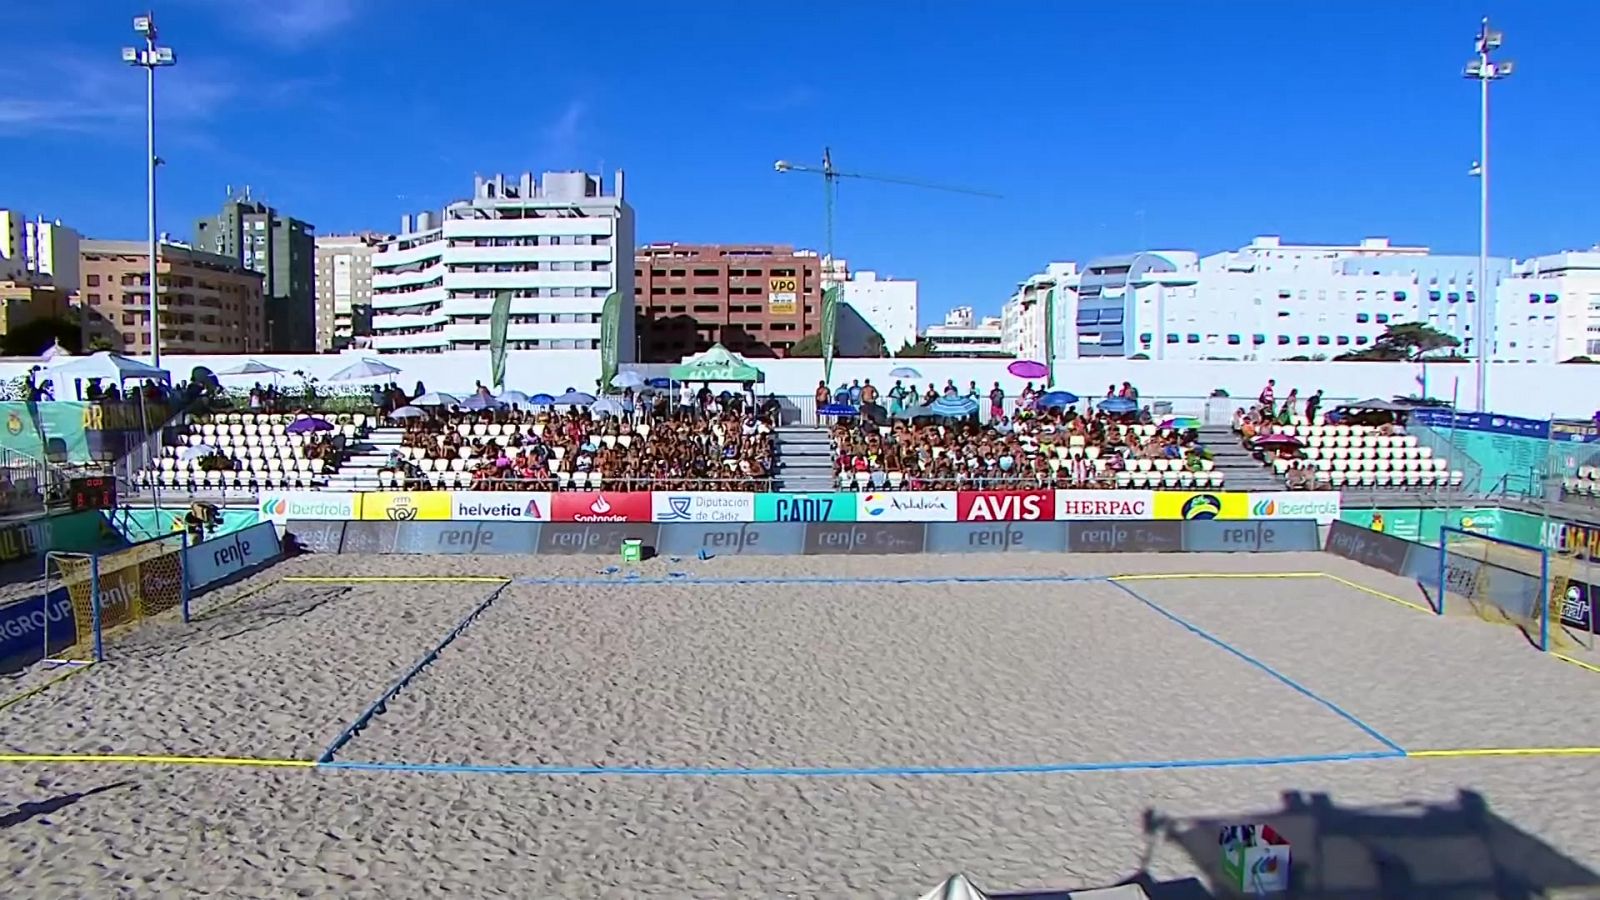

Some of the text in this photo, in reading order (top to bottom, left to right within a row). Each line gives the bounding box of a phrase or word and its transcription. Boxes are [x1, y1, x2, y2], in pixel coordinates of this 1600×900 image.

[770, 281, 796, 291] VPO
[458, 502, 521, 517] helvetia
[696, 495, 749, 508] Diputación
[890, 496, 948, 511] Andalucía
[967, 494, 1042, 521] AVIS
[1065, 501, 1145, 515] HERPAC
[696, 510, 708, 521] de
[438, 521, 494, 551] renfe
[552, 522, 601, 551] renfe
[703, 521, 760, 551] renfe
[818, 525, 867, 551] renfe
[968, 521, 1025, 551] renfe
[1081, 524, 1128, 548] renfe
[1222, 520, 1275, 551] renfe
[214, 533, 252, 566] renfe
[99, 575, 137, 611] enfe
